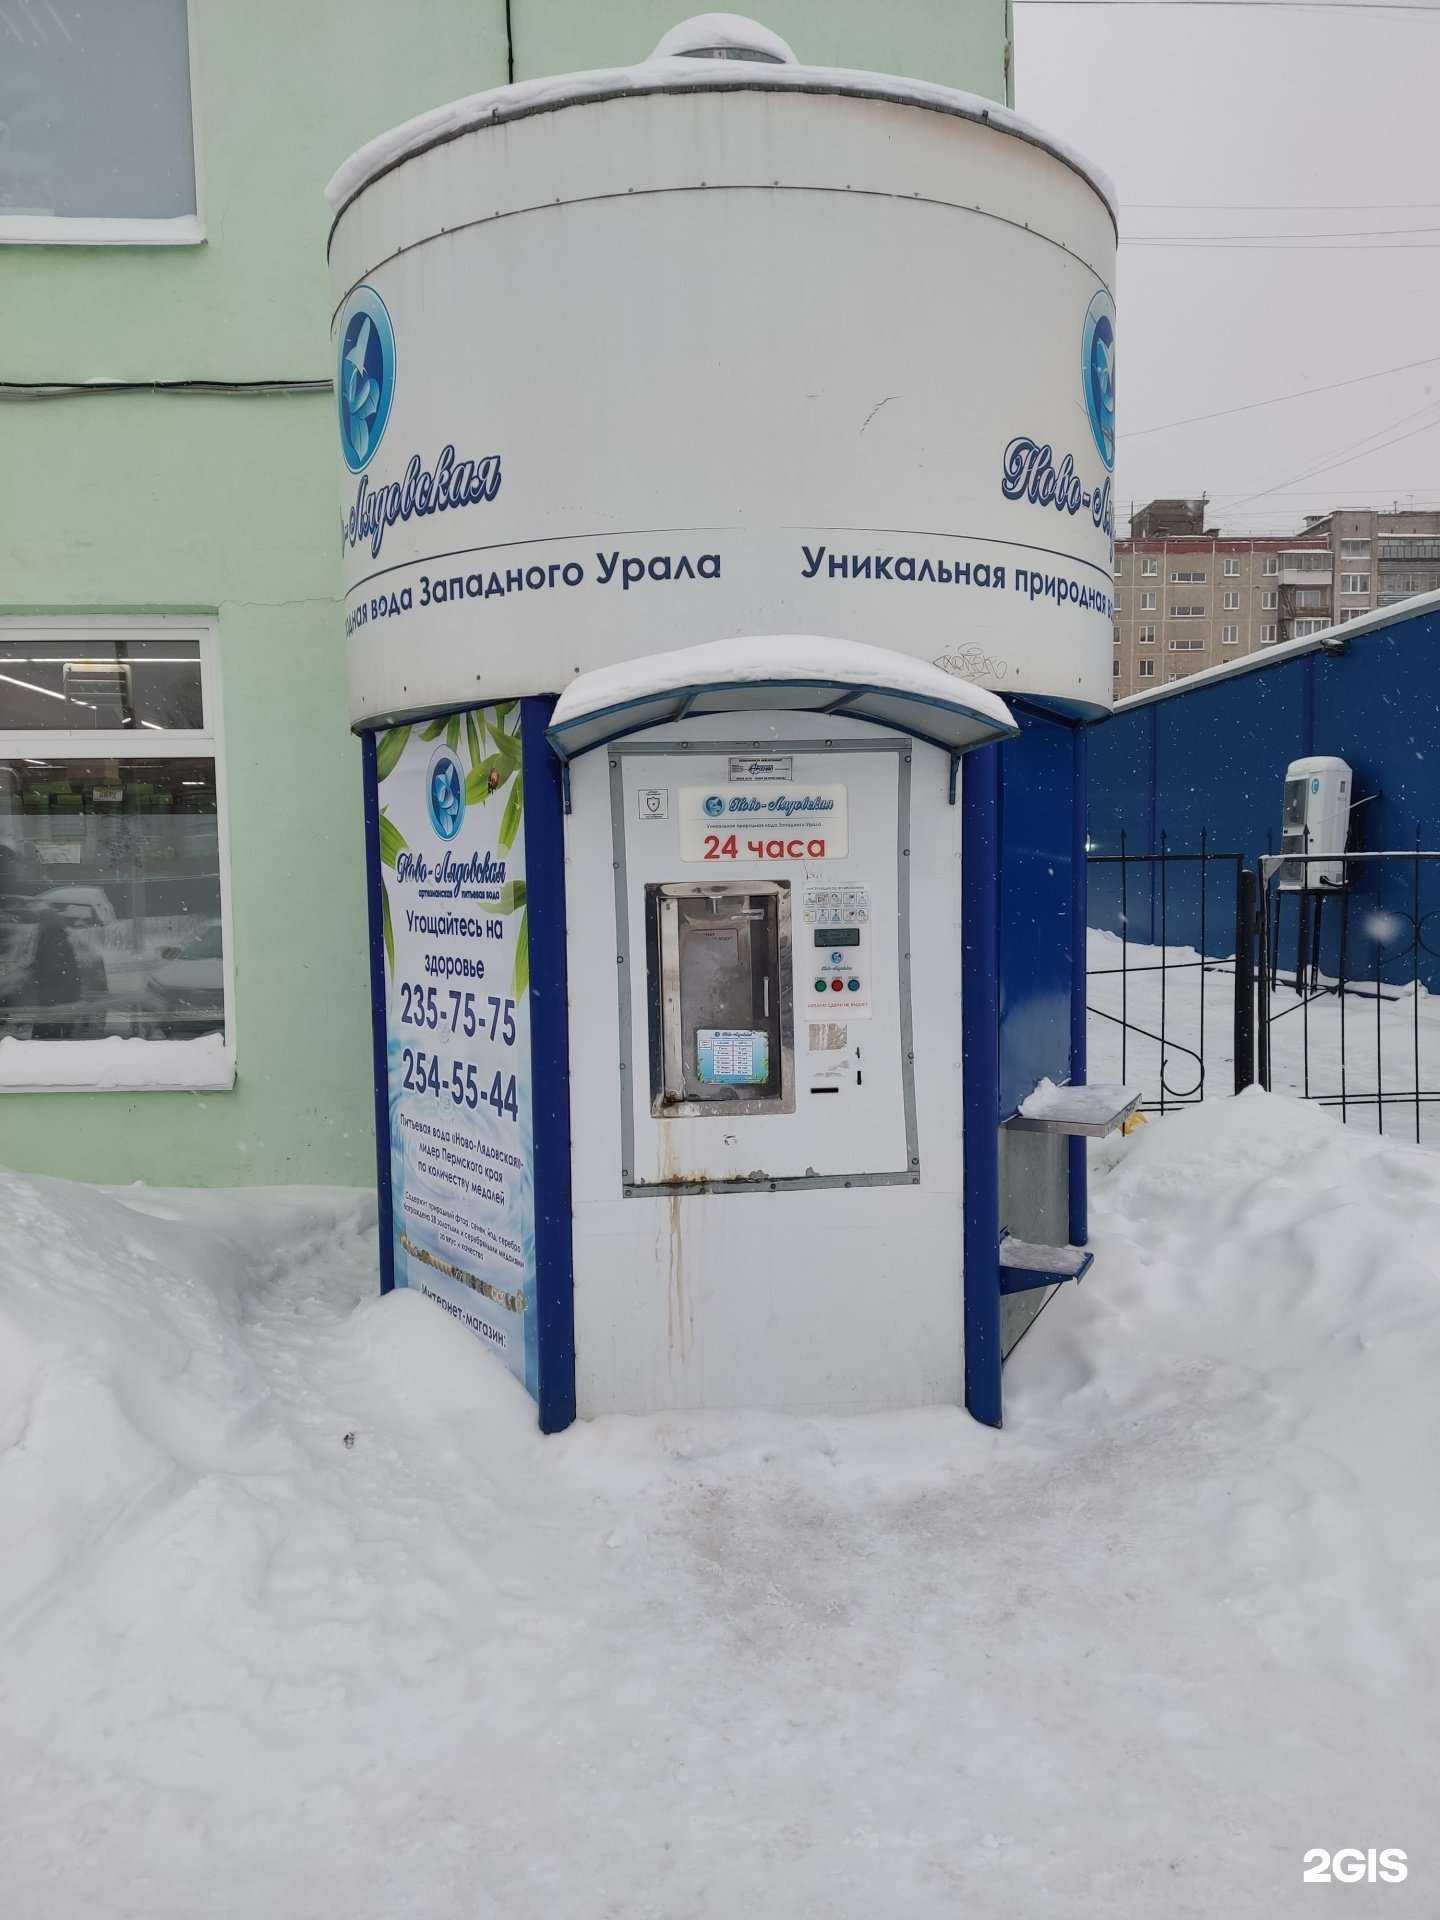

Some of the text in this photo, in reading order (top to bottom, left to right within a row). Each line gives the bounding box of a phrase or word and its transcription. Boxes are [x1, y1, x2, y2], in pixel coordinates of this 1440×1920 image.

[371, 587, 413, 619] вода
[419, 562, 584, 607] Западного
[597, 551, 722, 590] Урала
[801, 546, 1006, 590] Уникальная
[1015, 568, 1107, 616] природная
[728, 796, 834, 816] Ново-Лядовская
[703, 835, 825, 859] 24 часа
[397, 850, 506, 897] Ново-Лядовская
[406, 909, 503, 940] Угощайтесь на
[424, 954, 485, 979] здоровье
[400, 982, 516, 1046] 235-75-75
[402, 1048, 519, 1122] 254-55-44
[400, 1113, 431, 1135] Питьевая
[432, 1127, 450, 1142] вода
[418, 1161, 505, 1206] по количеству медалей
[419, 1143, 503, 1184] лидер Пермского края
